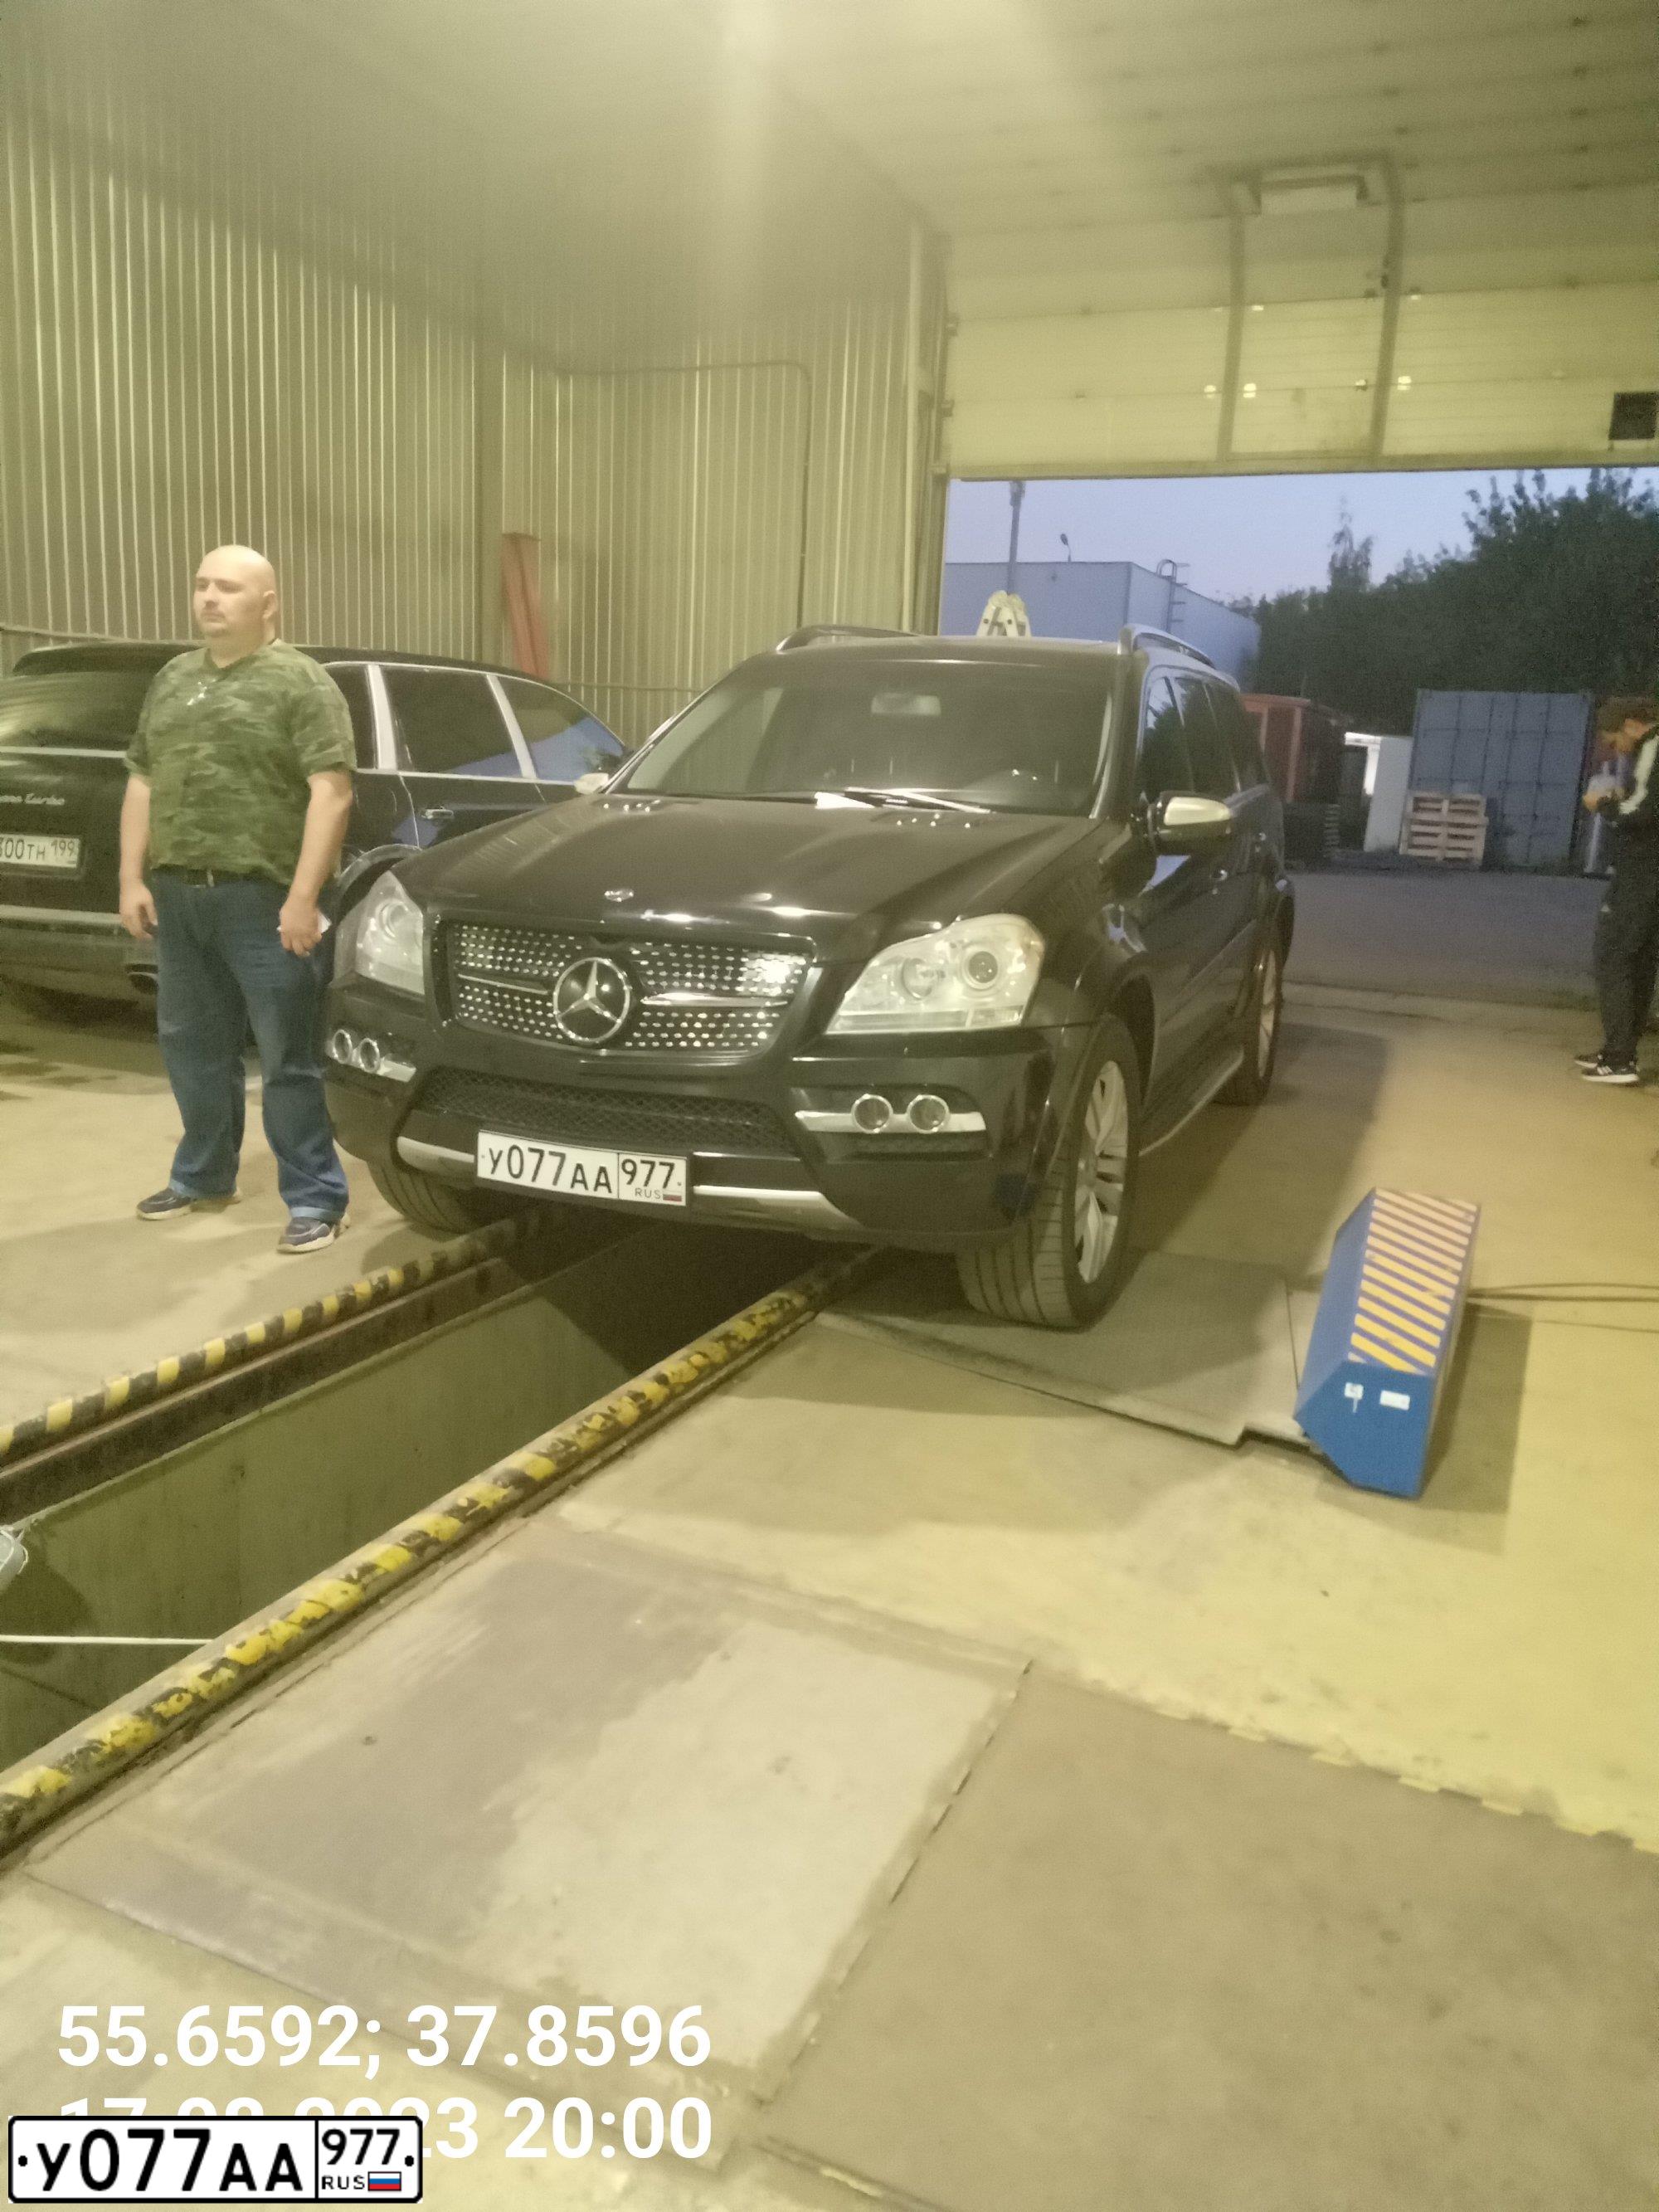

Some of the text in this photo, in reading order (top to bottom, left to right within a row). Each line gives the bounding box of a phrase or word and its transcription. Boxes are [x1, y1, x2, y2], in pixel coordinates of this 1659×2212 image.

[51, 839, 75, 857] 199
[489, 1144, 675, 1194] У077АА 977
[635, 1187, 661, 1200] RUS
